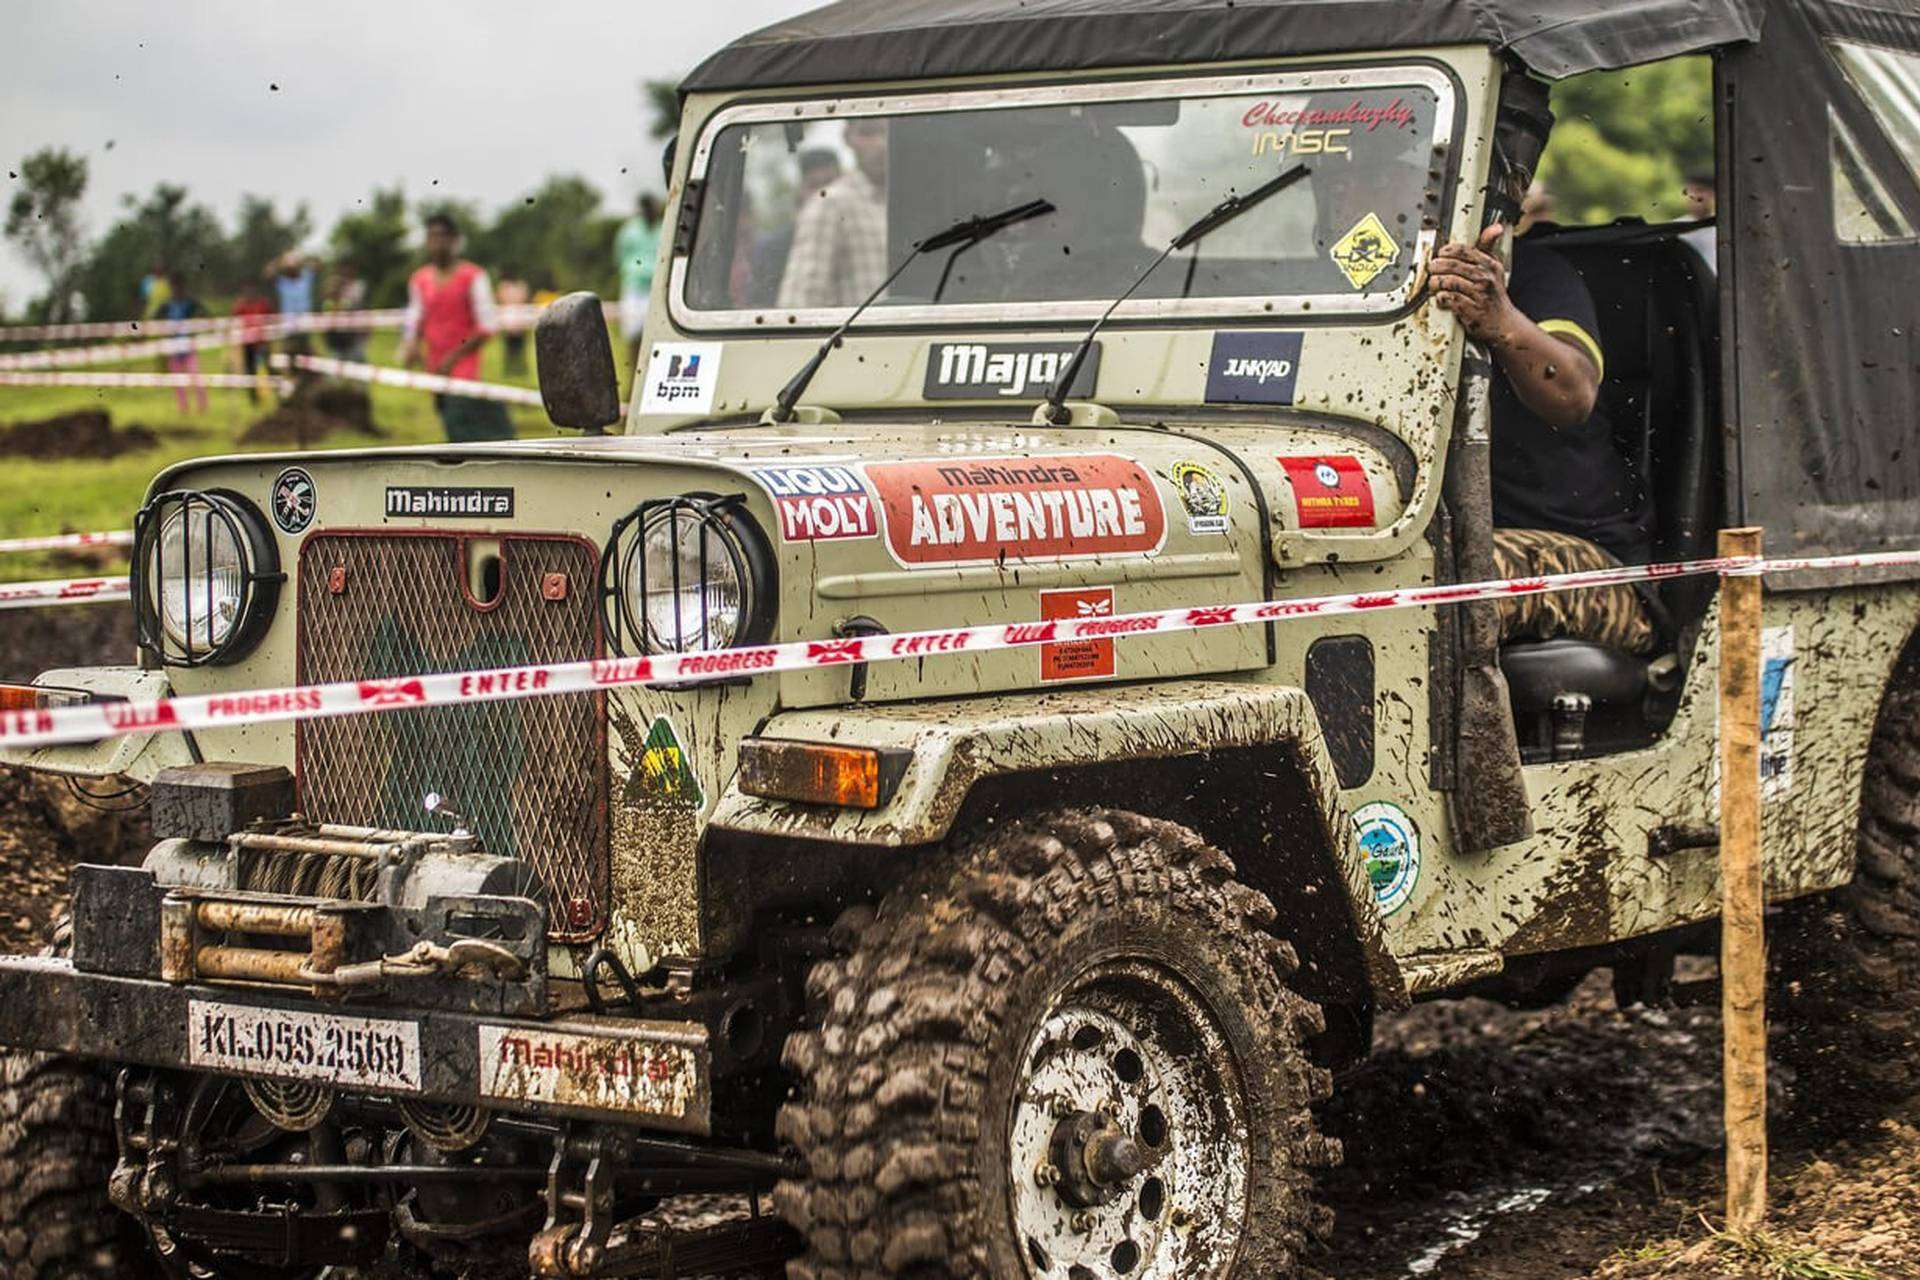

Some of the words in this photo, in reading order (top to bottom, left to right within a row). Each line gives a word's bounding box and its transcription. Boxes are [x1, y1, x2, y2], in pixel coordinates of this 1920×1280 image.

[656, 382, 700, 401] bpm
[755, 467, 861, 495] LIQUI
[937, 465, 1081, 487] Mahindra
[387, 490, 509, 513] Mahindra
[781, 497, 868, 538] MOLY
[911, 488, 1146, 546] ADVENTURE
[207, 691, 323, 717] PROGRESS
[460, 669, 549, 696] ENTER
[678, 650, 778, 675] PROGRESS
[891, 632, 971, 655] ENTER
